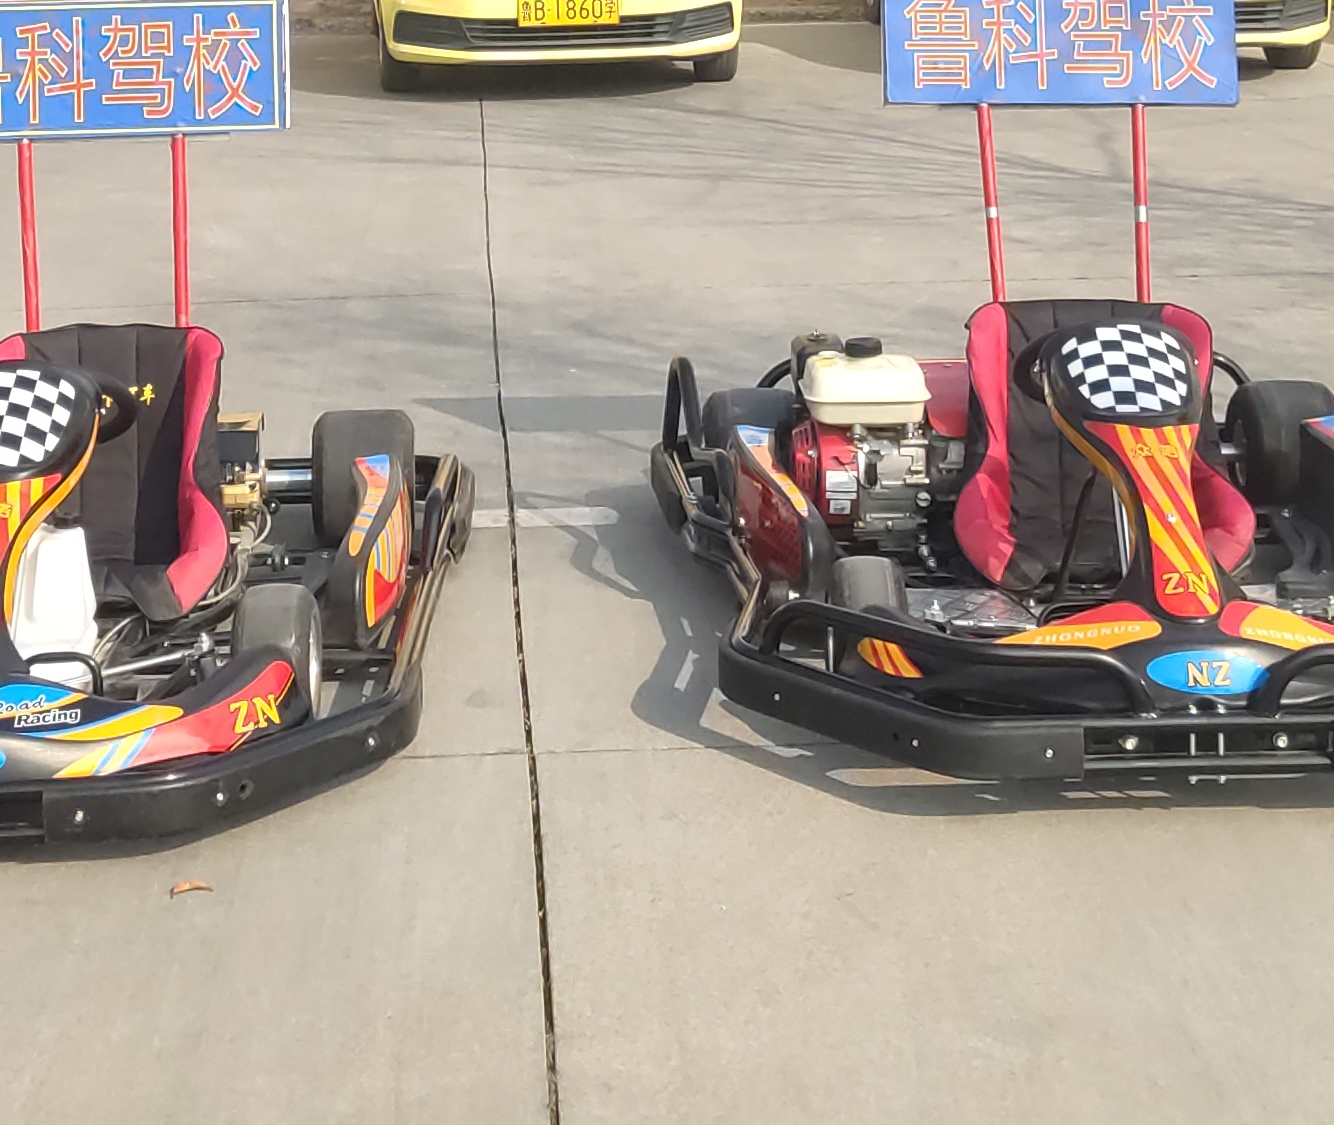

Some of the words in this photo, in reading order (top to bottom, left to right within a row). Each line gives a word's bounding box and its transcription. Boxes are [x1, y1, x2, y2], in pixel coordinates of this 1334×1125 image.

[1161, 571, 1210, 595] ZN
[14, 708, 81, 728] Racing
[229, 693, 281, 734] ZN
